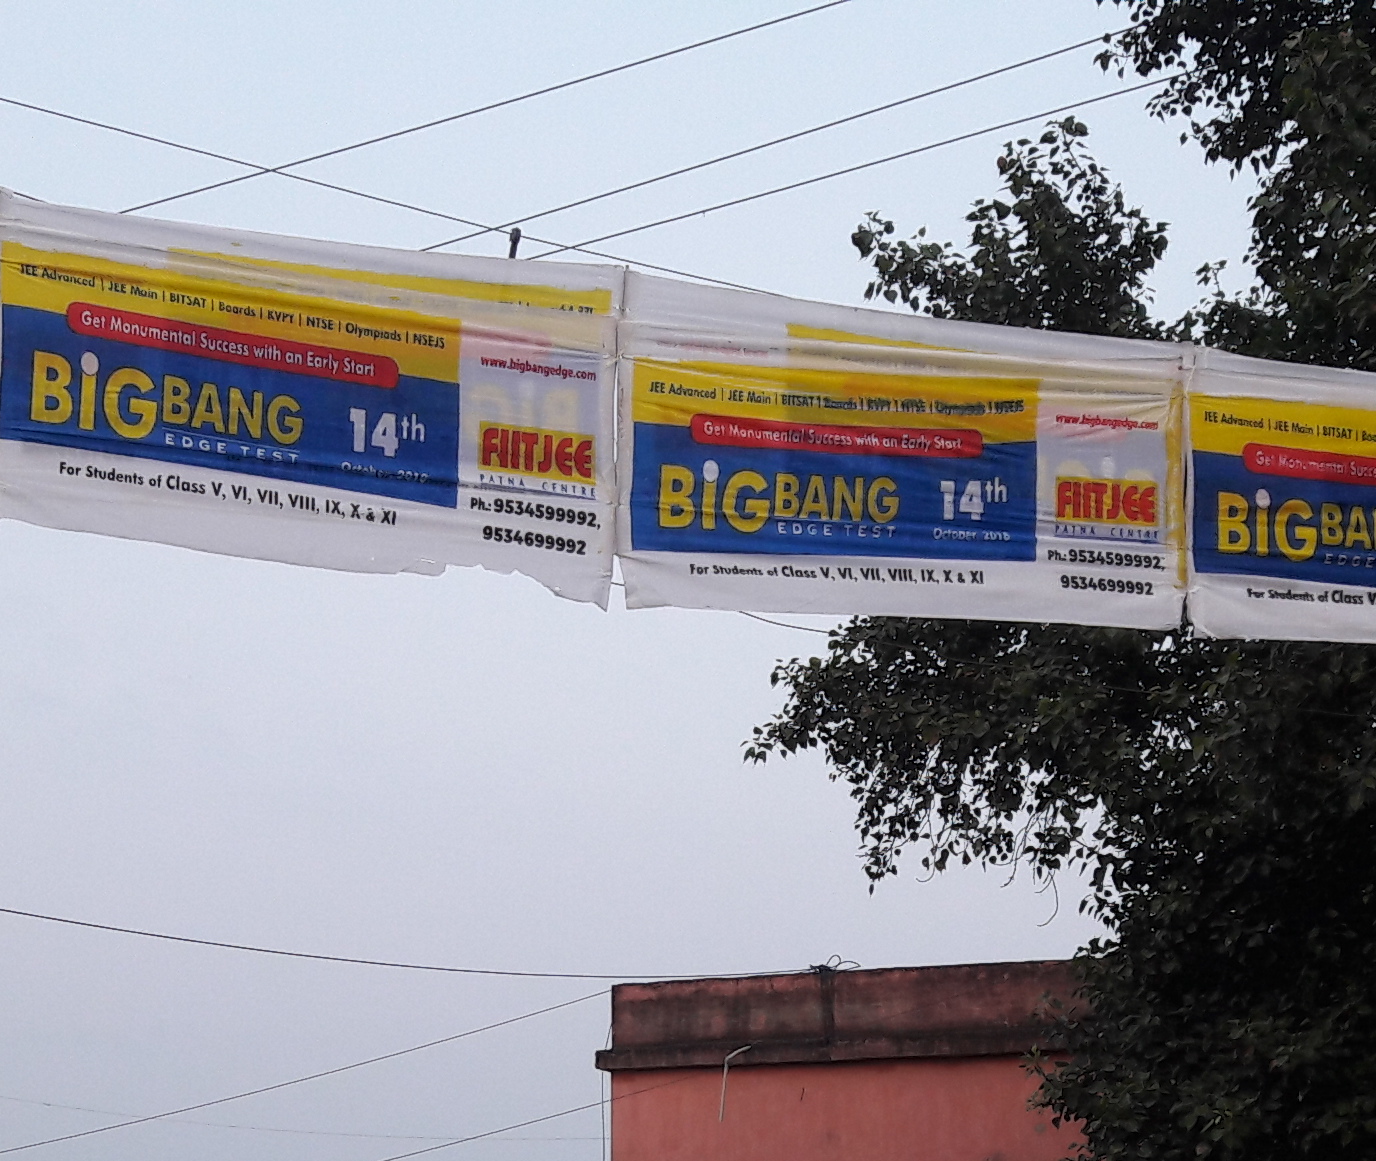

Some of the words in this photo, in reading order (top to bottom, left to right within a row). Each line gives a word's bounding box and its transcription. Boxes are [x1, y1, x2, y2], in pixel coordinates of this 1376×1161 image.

[21, 264, 37, 276] JEE
[42, 267, 95, 287] Advanced
[108, 281, 126, 293] JEE
[130, 286, 157, 299] Main
[170, 293, 207, 308] BITSAT
[219, 301, 255, 317] Boards
[268, 309, 294, 324] KVPY
[306, 316, 334, 330] NTSE
[346, 322, 401, 342] Olympiads
[413, 333, 445, 349] NSEJS
[82, 311, 105, 329] Get
[110, 316, 196, 346] Monumental
[200, 332, 249, 357] Success
[253, 345, 281, 361] with
[285, 353, 303, 365] an
[307, 352, 339, 374] Early
[343, 358, 375, 376] Start
[480, 356, 596, 381] www.bigbangedge.com
[165, 433, 226, 454] EDGE
[240, 446, 300, 464] TEST
[349, 407, 425, 458] 14th
[481, 427, 593, 479] FIITJEE
[59, 462, 81, 477] For
[86, 466, 144, 486] Students
[149, 475, 161, 488] of
[166, 476, 206, 494] Class
[212, 482, 226, 500] V,
[232, 484, 252, 504] VI,
[257, 488, 284, 509] VII,
[288, 494, 320, 514] VIII,
[326, 500, 345, 518] IX,
[350, 503, 361, 519] X
[381, 508, 397, 526] XI
[939, 476, 1008, 521] 14th
[482, 526, 587, 556] 9534699992
[777, 521, 832, 536] EDGE
[844, 525, 896, 538] TEST
[1060, 575, 1154, 596] 9534699992
